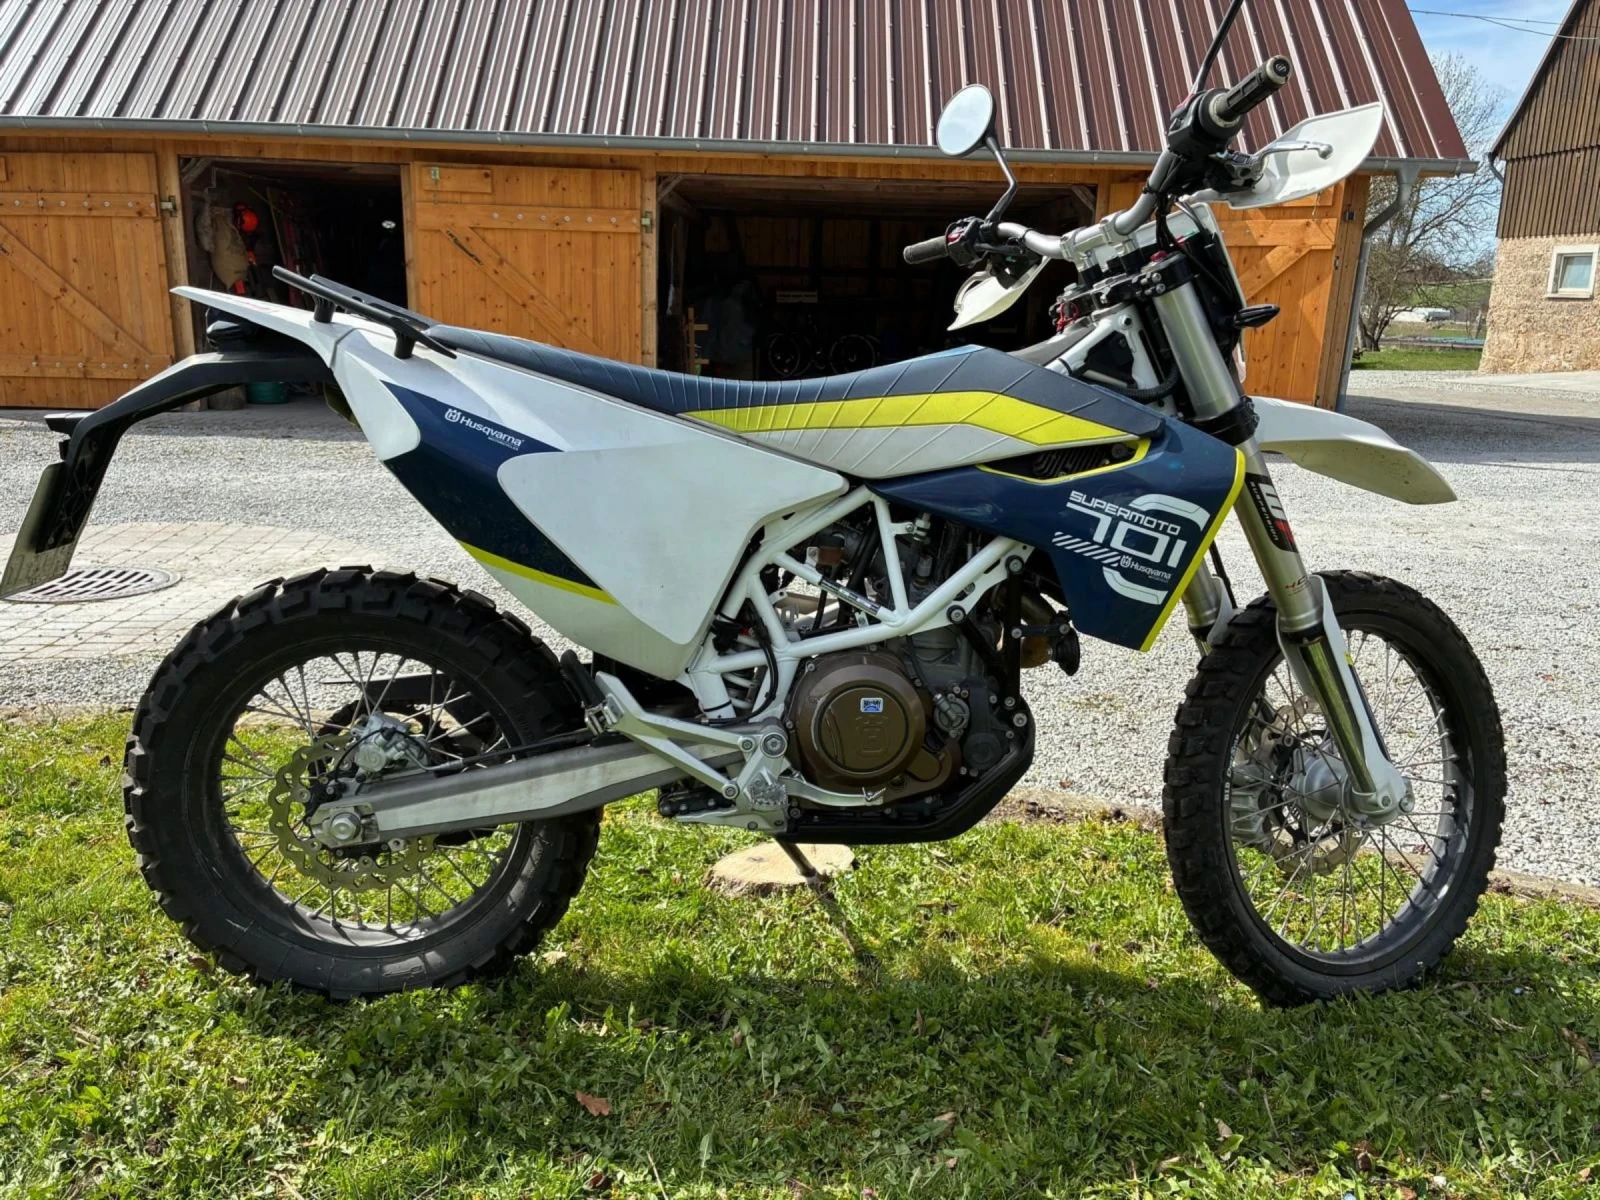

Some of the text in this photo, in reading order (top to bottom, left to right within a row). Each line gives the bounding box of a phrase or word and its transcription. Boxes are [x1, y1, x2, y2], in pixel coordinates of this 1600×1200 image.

[460, 416, 524, 447] Husqvarna
[1069, 490, 1181, 536] SUPERMOTO
[1066, 502, 1188, 568] 701
[1130, 560, 1172, 580] Husqvarna
